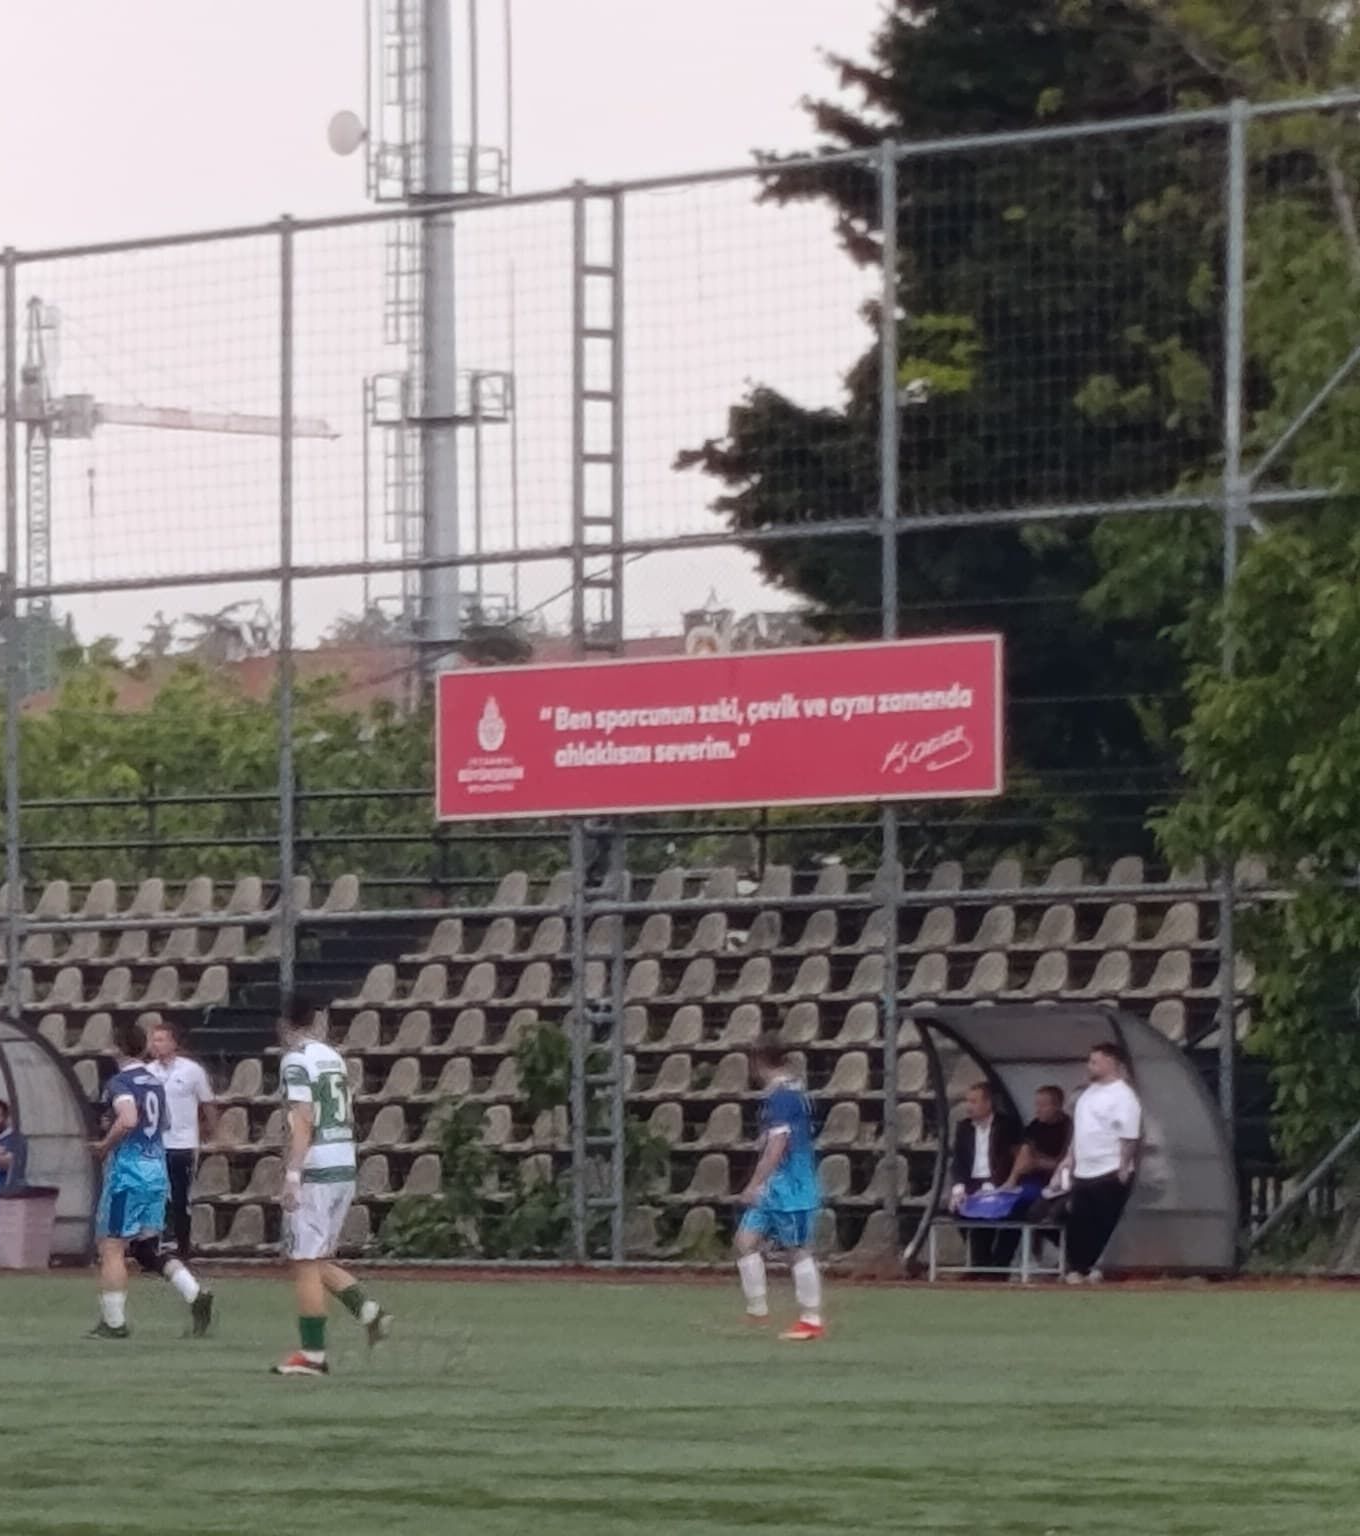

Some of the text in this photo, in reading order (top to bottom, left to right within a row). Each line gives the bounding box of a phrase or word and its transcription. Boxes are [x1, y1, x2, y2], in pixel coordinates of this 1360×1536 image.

[594, 704, 696, 735] sporcunun
[746, 692, 800, 726] çevik
[802, 697, 828, 718] ve
[876, 681, 974, 714] zamanda
